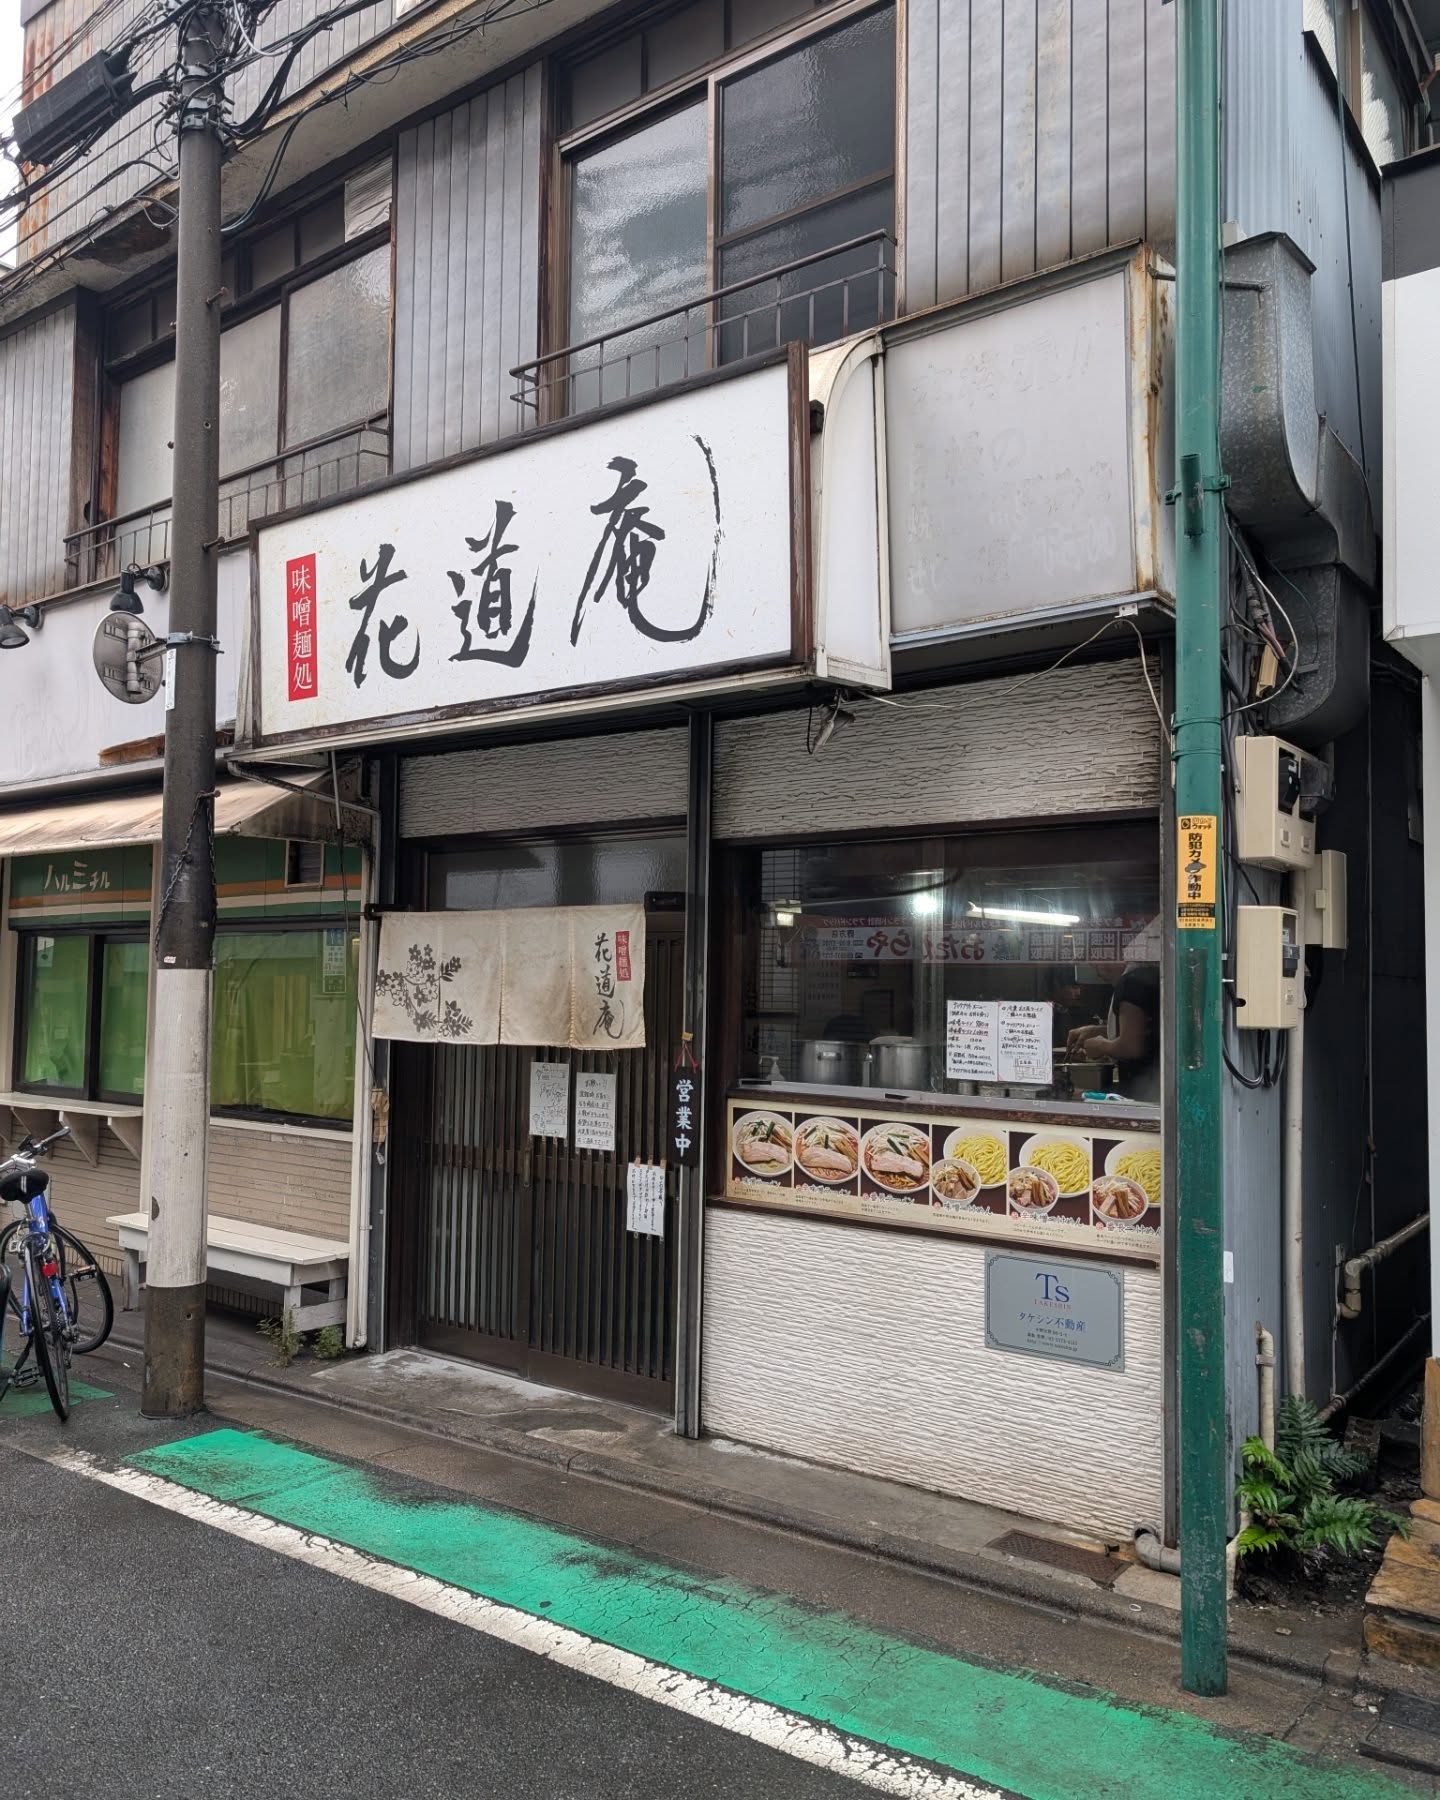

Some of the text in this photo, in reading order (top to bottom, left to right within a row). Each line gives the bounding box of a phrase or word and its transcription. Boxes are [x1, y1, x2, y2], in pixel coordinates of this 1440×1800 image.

[345, 434, 726, 689] 花道庵
[290, 563, 313, 693] 味噌麺処
[44, 860, 111, 892] ハルミチル
[592, 932, 625, 1040] 花道庵
[674, 1079, 694, 1158] 営業中
[1018, 1311, 1086, 1333] タケシン不動産
